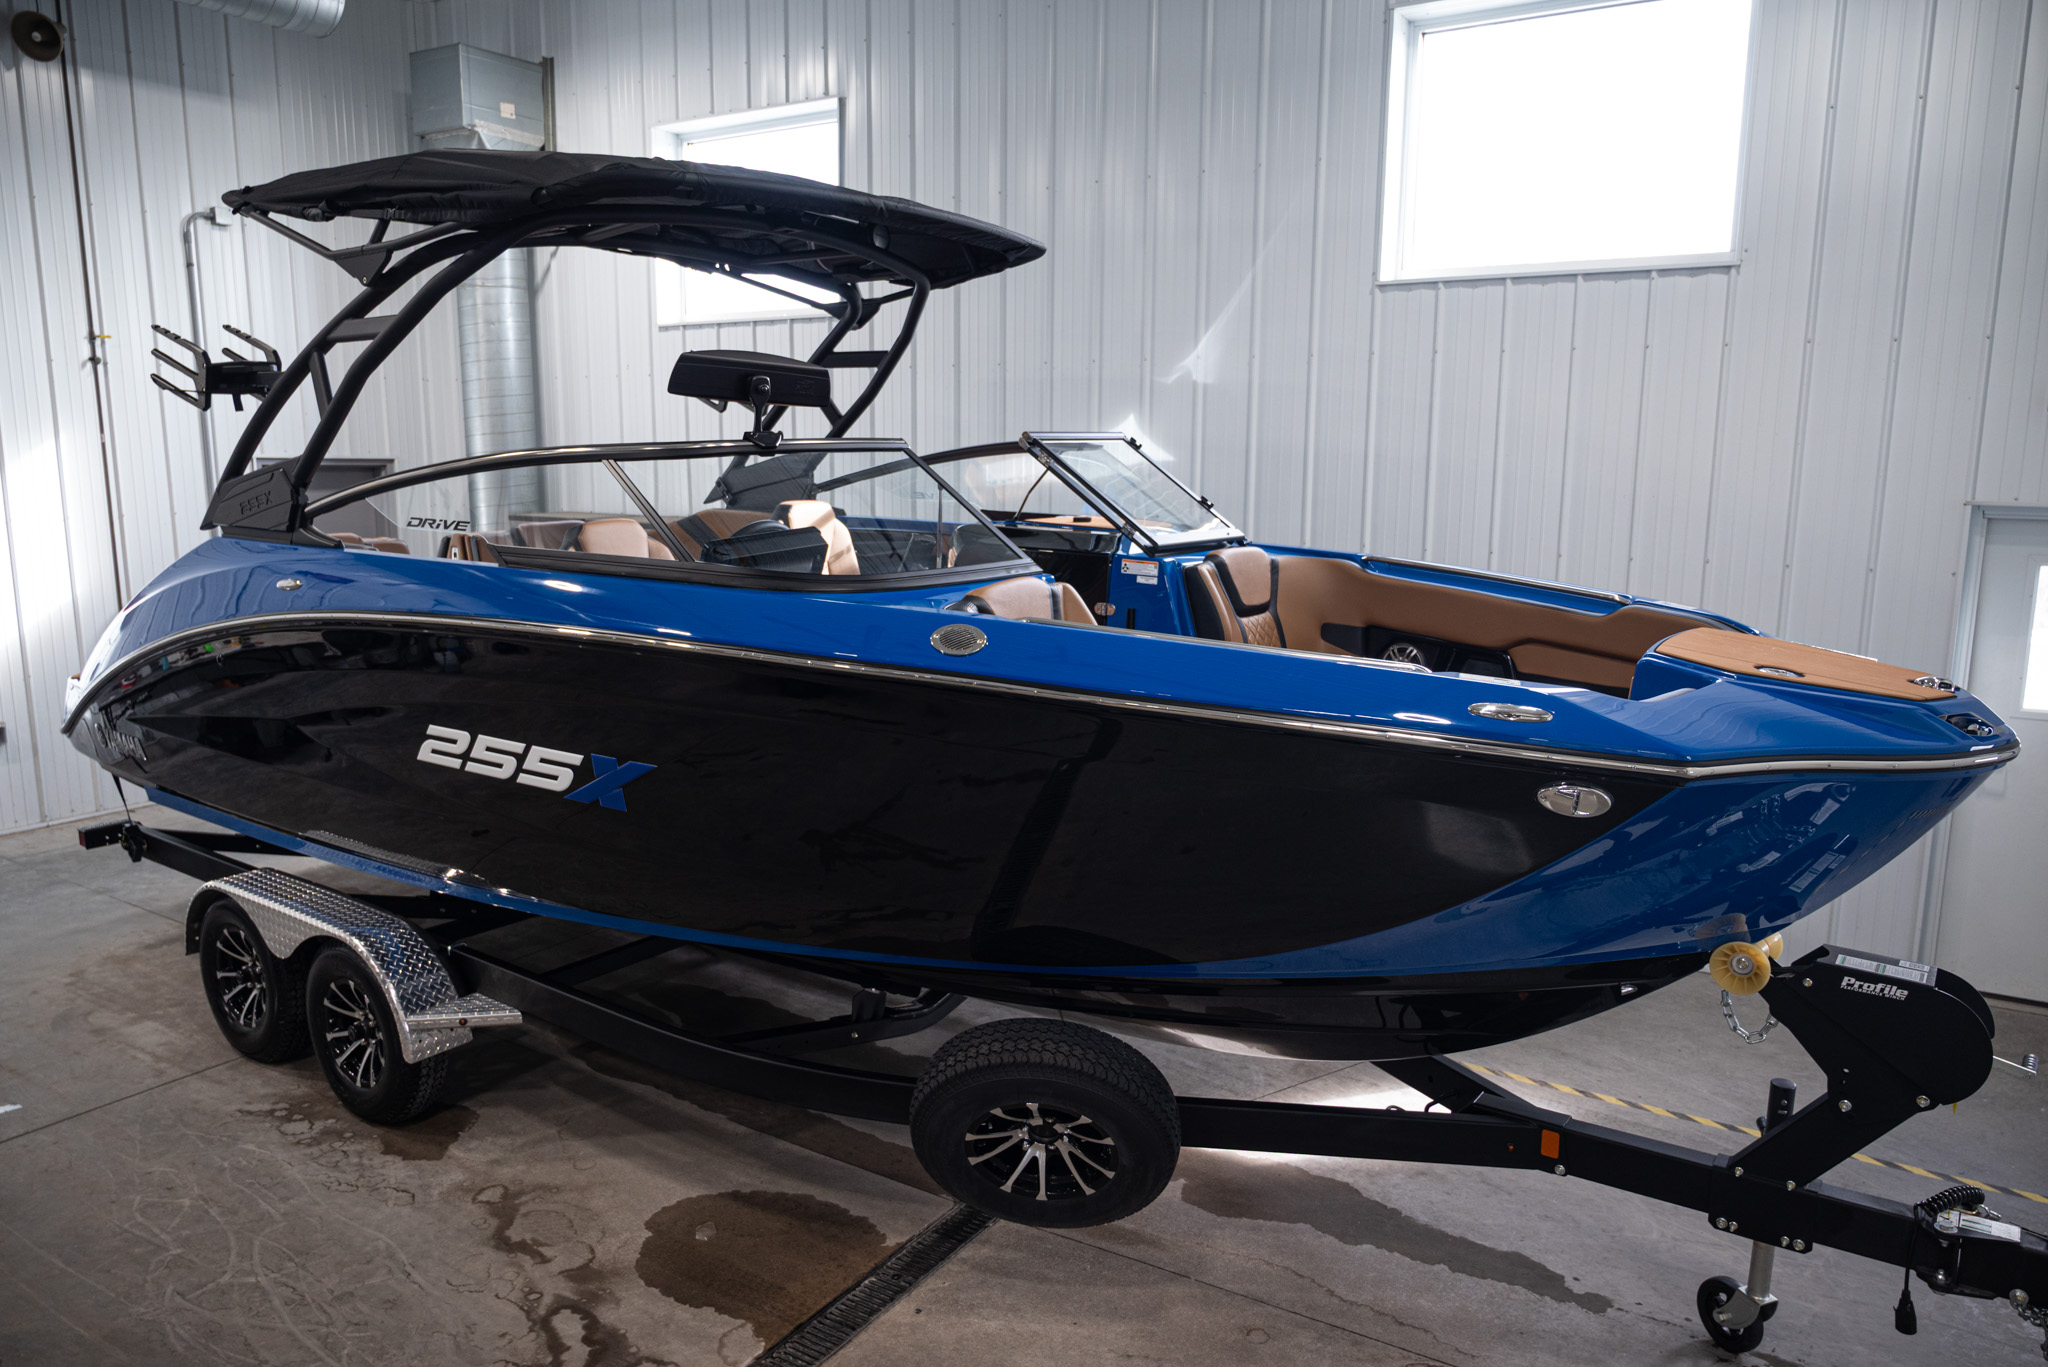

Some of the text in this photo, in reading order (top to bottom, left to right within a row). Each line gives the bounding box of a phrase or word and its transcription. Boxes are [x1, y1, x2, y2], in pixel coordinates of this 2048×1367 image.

[416, 723, 659, 813] 255X
[1840, 985, 1906, 1001] PERFORMANCE WINCH
[1841, 976, 1909, 998] Profile
